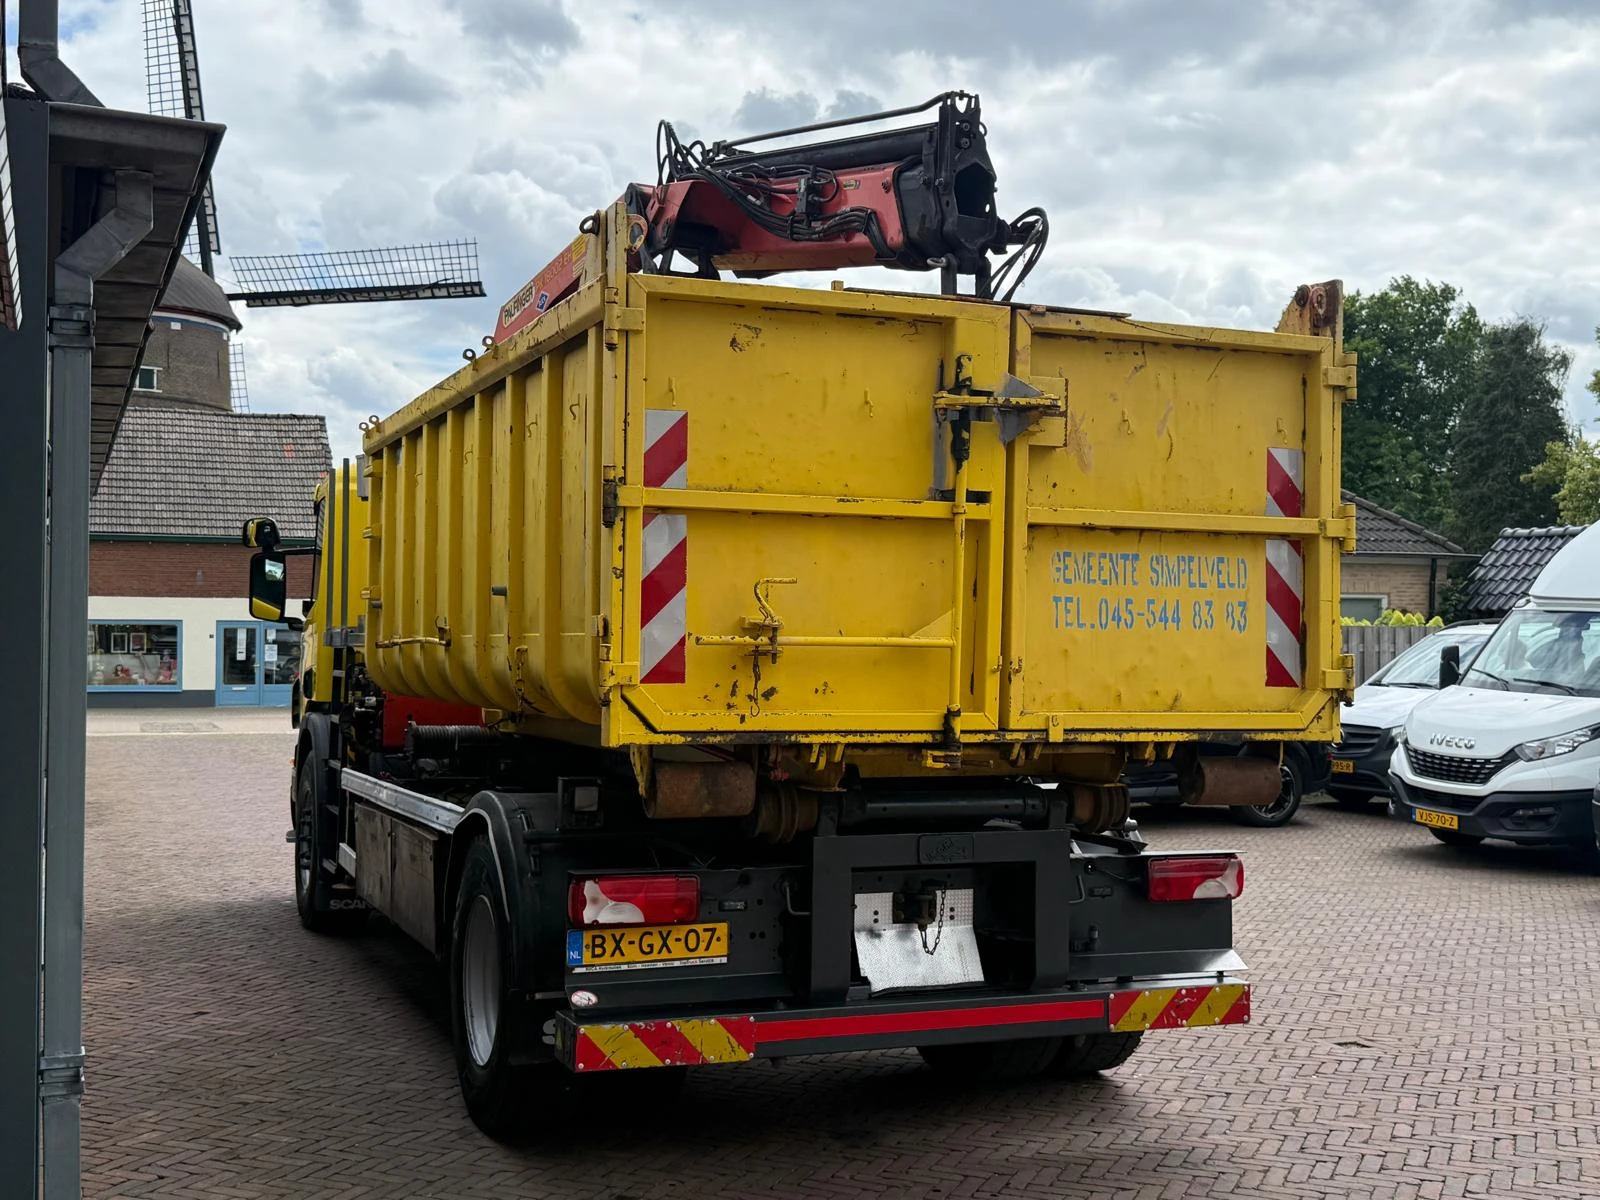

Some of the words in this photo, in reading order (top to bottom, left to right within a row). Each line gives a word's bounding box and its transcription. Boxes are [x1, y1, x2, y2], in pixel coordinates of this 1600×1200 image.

[504, 286, 533, 325] PALFINGER
[1052, 551, 1140, 586] GEMEENTE
[1150, 555, 1248, 589] SIMPELVELD
[1192, 600, 1214, 630] 83
[1430, 733, 1475, 749] IVECO
[1332, 761, 1351, 771] 95-R
[1419, 810, 1455, 827] VJS-70-Z
[591, 927, 717, 959] BX-GX-07
[569, 950, 582, 960] NL
